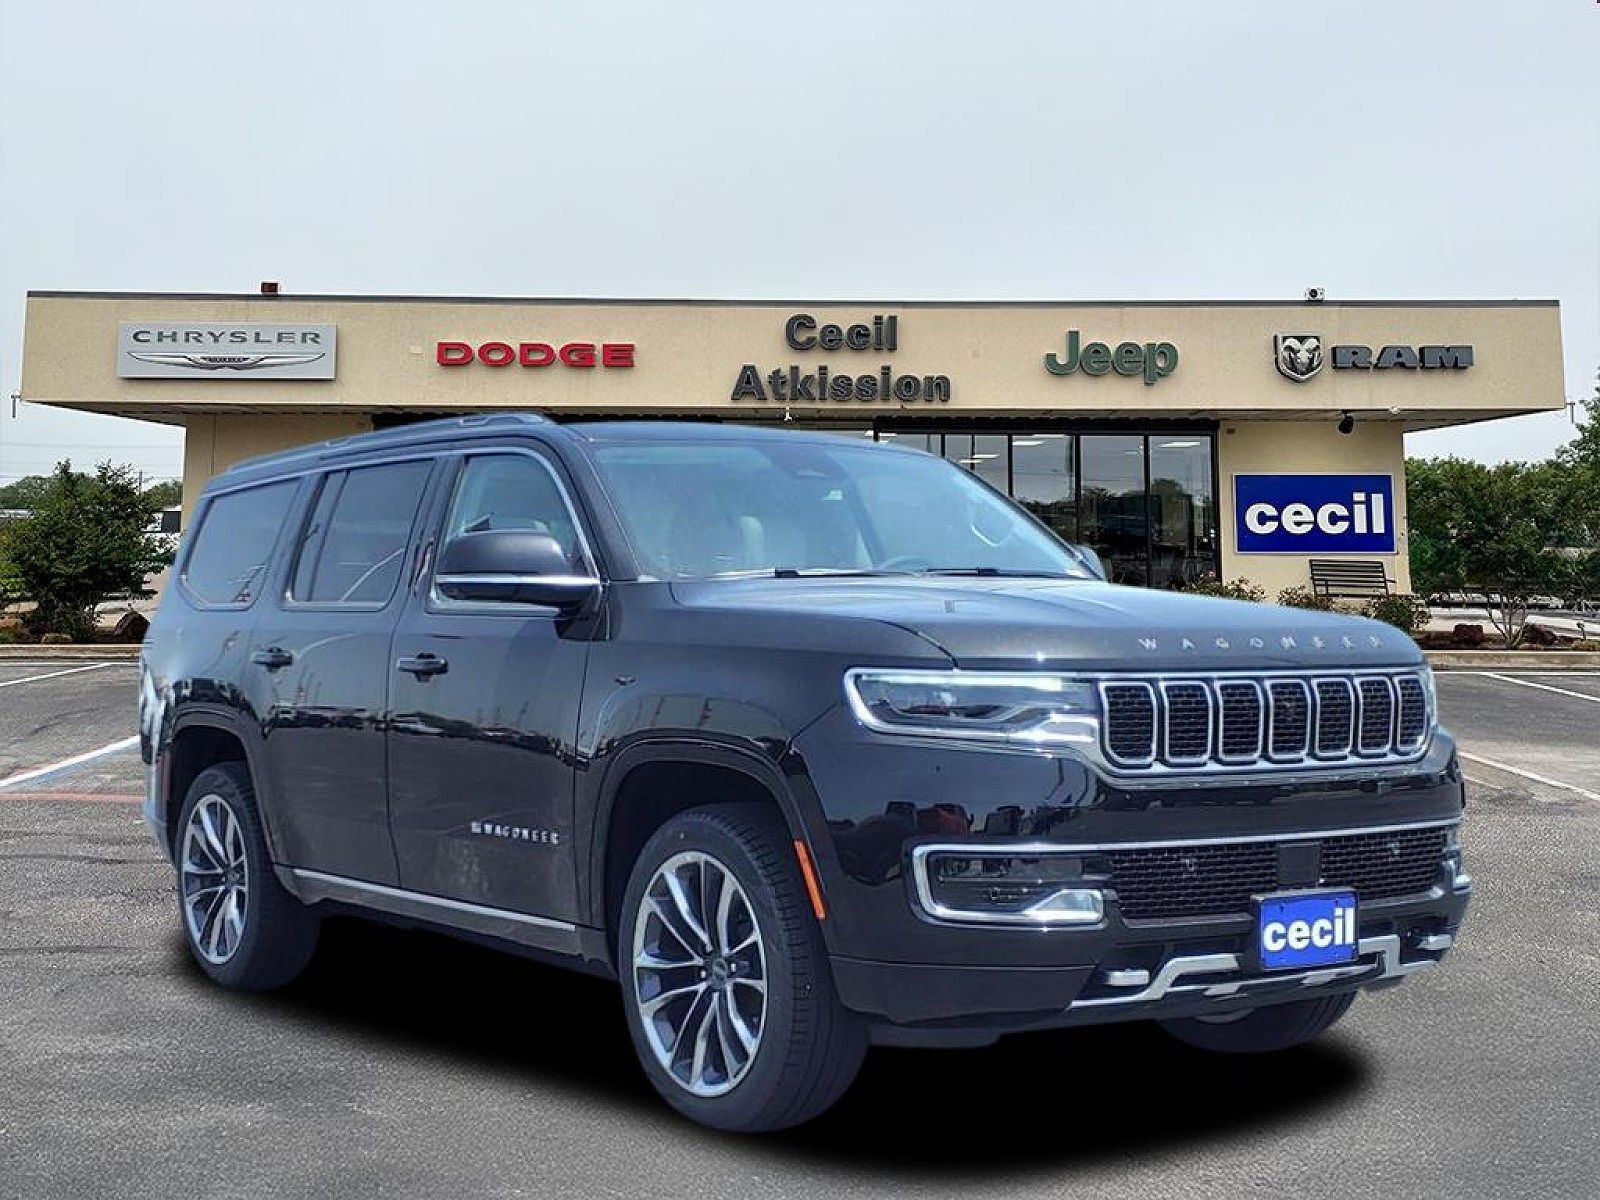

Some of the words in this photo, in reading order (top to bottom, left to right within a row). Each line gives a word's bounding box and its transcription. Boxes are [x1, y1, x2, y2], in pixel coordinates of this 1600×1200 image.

[132, 330, 322, 344] CHRYSLER
[785, 314, 898, 351] Cecil
[437, 341, 635, 367] DODGE
[1045, 330, 1179, 386] Jeep
[1332, 345, 1474, 369] RAM
[731, 364, 951, 401] Atkission
[1245, 491, 1386, 535] cecil
[1263, 907, 1355, 952] cecil
